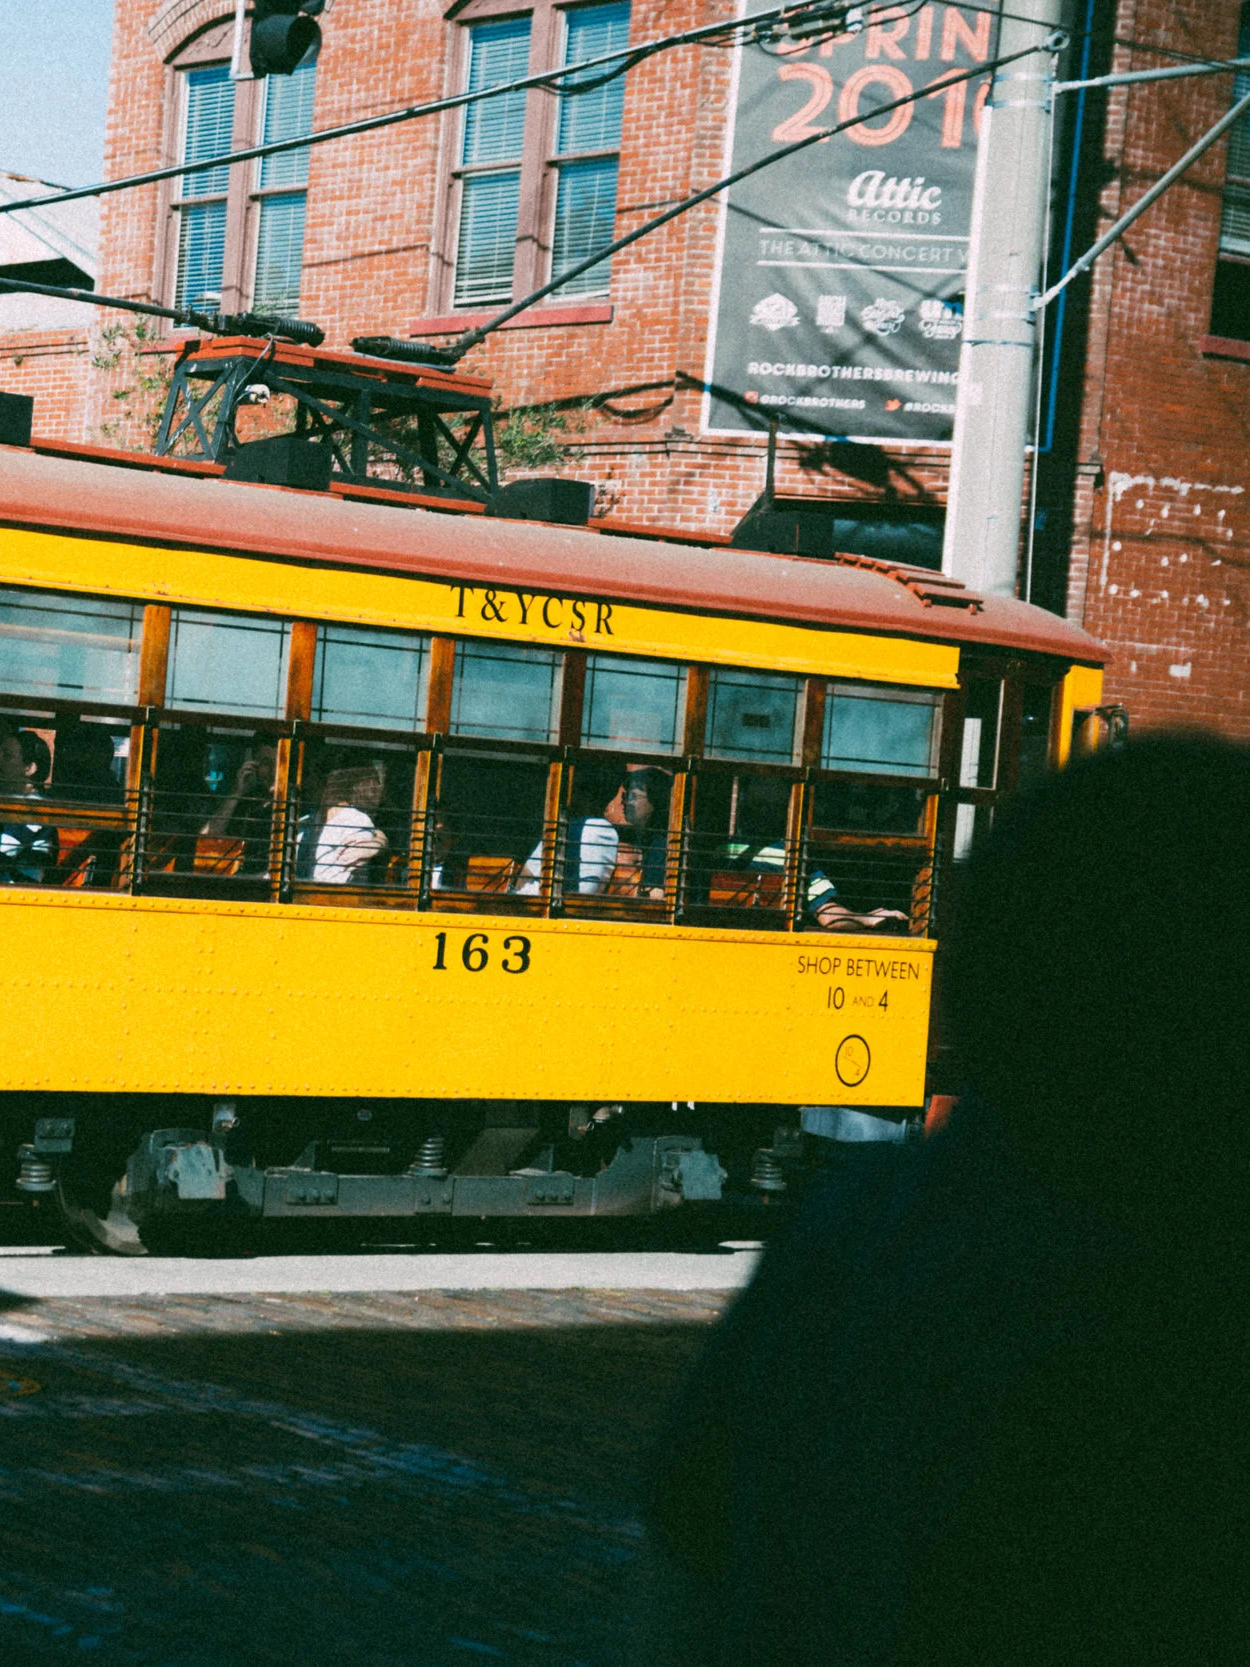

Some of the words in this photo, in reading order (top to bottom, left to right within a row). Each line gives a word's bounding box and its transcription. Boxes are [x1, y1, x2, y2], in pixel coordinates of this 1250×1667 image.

[847, 170, 943, 210] Attic
[846, 208, 942, 225] RECORDS
[759, 239, 799, 255] THE
[800, 242, 854, 258] ATTIC
[858, 244, 950, 262] CONCERT
[450, 586, 614, 635] T&YCSR
[432, 932, 531, 974] 163
[797, 955, 841, 975] SHOP
[846, 958, 920, 980] BETWEEN
[827, 986, 845, 1010] 10
[853, 996, 874, 1008] AND
[878, 990, 888, 1012] 4
